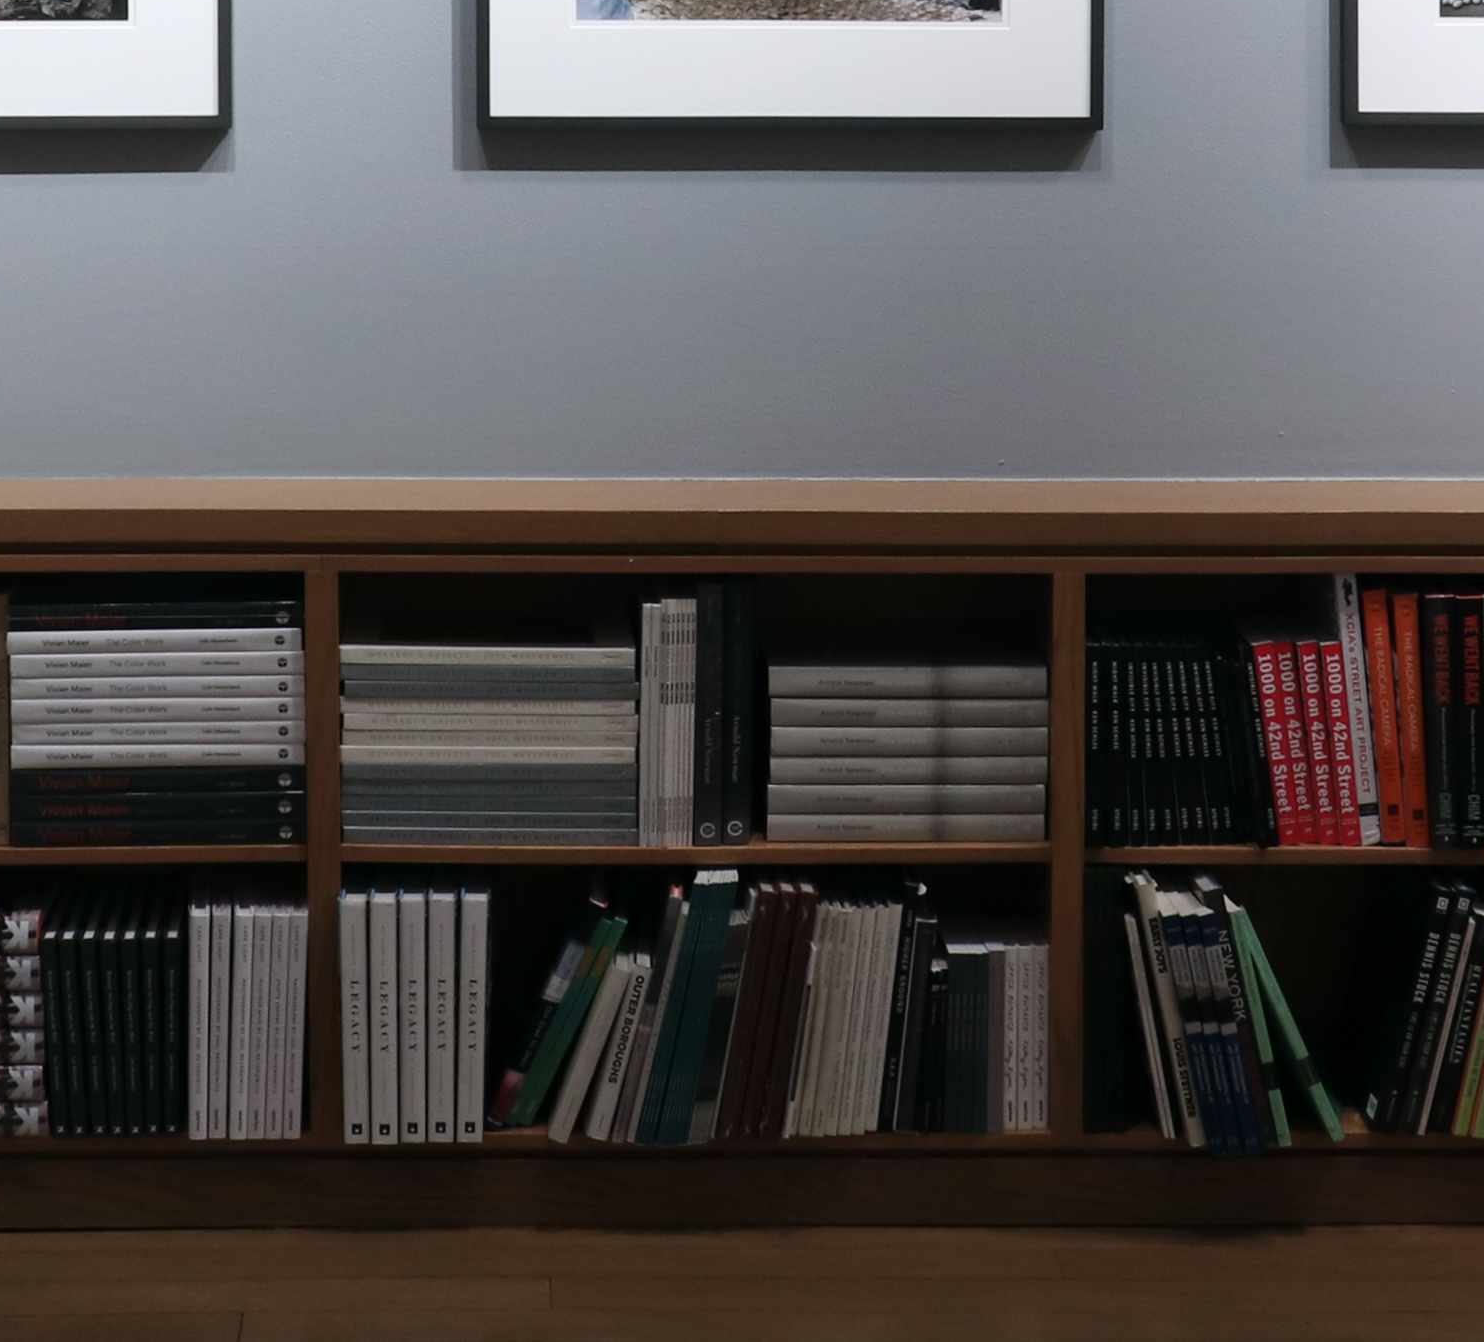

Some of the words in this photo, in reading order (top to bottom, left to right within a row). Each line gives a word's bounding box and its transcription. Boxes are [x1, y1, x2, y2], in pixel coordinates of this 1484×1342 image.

[1373, 626, 1384, 648] THE
[1404, 630, 1414, 652] THE
[1434, 614, 1450, 634] WE
[1463, 614, 1478, 634] WE
[1278, 651, 1296, 692] 1000
[1376, 650, 1388, 695] RADICAL
[1434, 636, 1450, 670] WENT
[1464, 636, 1479, 670] WENT
[1257, 653, 1276, 695] 1000
[1302, 653, 1320, 694] 1000
[1325, 653, 1342, 694] 1000
[1349, 656, 1362, 702] STREET
[1405, 655, 1416, 700] RADICAL
[1436, 672, 1450, 704] BACK
[1464, 672, 1479, 705] BACK
[1264, 698, 1278, 716] on
[1284, 696, 1297, 714] on
[1308, 697, 1322, 716] on
[1330, 698, 1343, 717] on
[1354, 707, 1364, 734] ART
[1380, 698, 1391, 746] CAMERA
[732, 714, 741, 744] Arnold
[1266, 720, 1284, 760] 42nd
[1285, 718, 1303, 758] 42nd
[1310, 720, 1327, 760] 42nd
[1332, 720, 1349, 760] 42nd
[1408, 704, 1418, 751] CAMERA
[732, 746, 740, 783] Newman
[1357, 737, 1371, 794] PROJECT
[1273, 764, 1292, 813] Street
[1291, 762, 1311, 811] Street
[1314, 764, 1332, 813] Street
[1336, 764, 1354, 814] Street
[1467, 794, 1481, 820] CHIM
[1148, 918, 1164, 948] EARLY
[1422, 932, 1440, 969] DENNIS
[1442, 933, 1462, 968] DENNIS
[1152, 948, 1167, 974] JOYS
[1218, 929, 1234, 970] NEW
[1228, 974, 1247, 1022] YORK
[625, 976, 645, 1016] OUTER
[1412, 971, 1430, 1004] STOCK
[1434, 972, 1452, 1005] STOCK
[350, 980, 360, 1054] LEGACY
[380, 980, 389, 1054] LEGACY
[408, 979, 418, 1052] LEGACY
[437, 978, 446, 1052] LEGACY
[468, 979, 478, 1052] LEGACY
[608, 1017, 634, 1084] BOROUGHS
[1172, 1037, 1187, 1067] LOUIS
[1178, 1070, 1196, 1118] STETTNER
